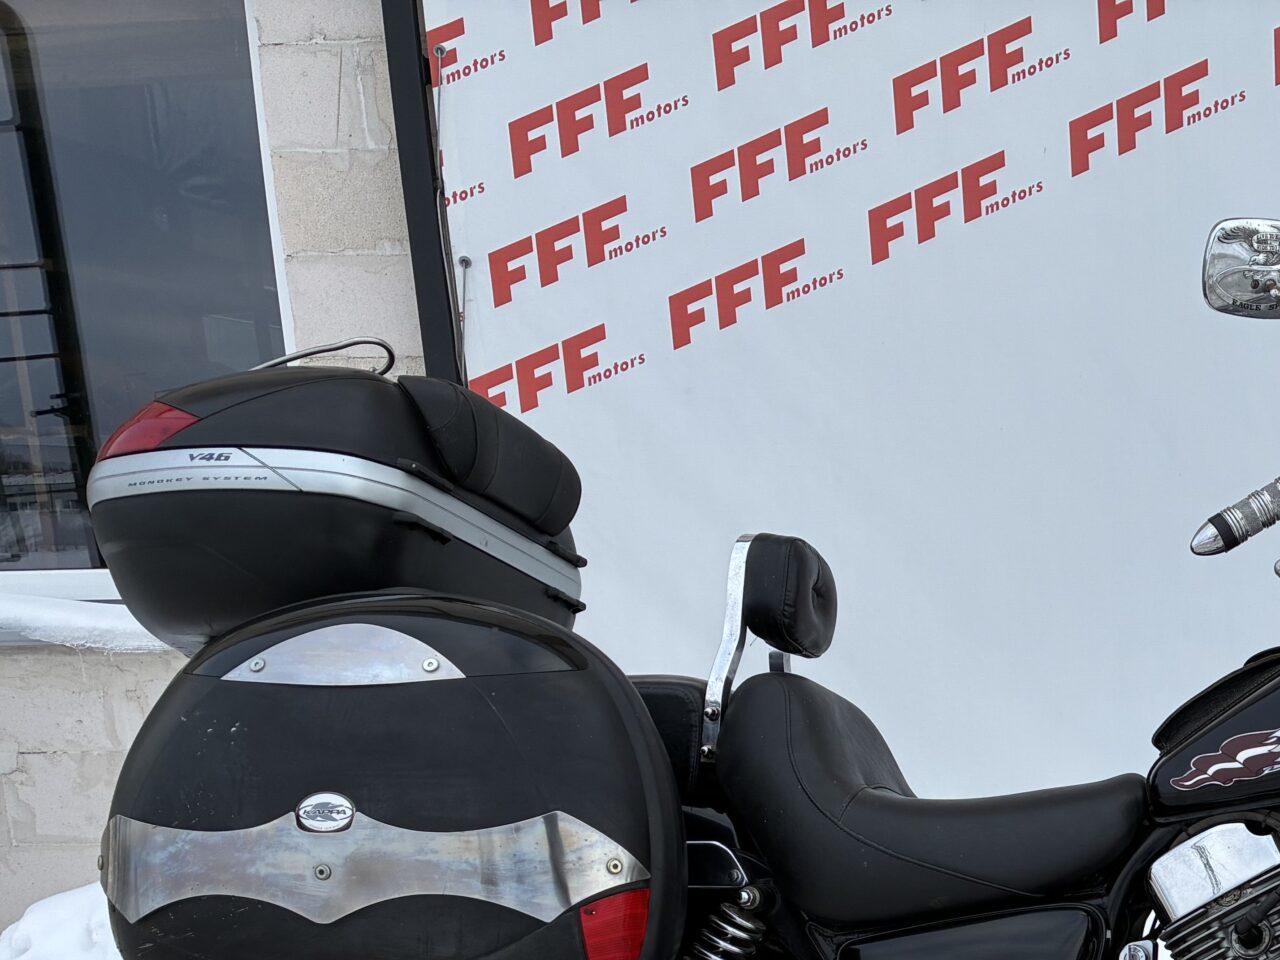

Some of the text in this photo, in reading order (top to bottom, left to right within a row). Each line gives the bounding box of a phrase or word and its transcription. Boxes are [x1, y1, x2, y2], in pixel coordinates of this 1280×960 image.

[445, 49, 506, 85] motors
[833, 4, 893, 40] motors
[892, 16, 1032, 135] FFF
[1011, 47, 1071, 83] motors
[508, 63, 689, 179] FFF motors
[690, 107, 868, 223] FFF motors
[1068, 59, 1247, 177] FFF motors
[488, 195, 667, 308] FFF motors
[867, 150, 1044, 265] FFF motors
[668, 238, 844, 350] FFF motors
[587, 353, 646, 386] motors
[127, 477, 193, 487] MONOKEY
[188, 452, 231, 462] V46
